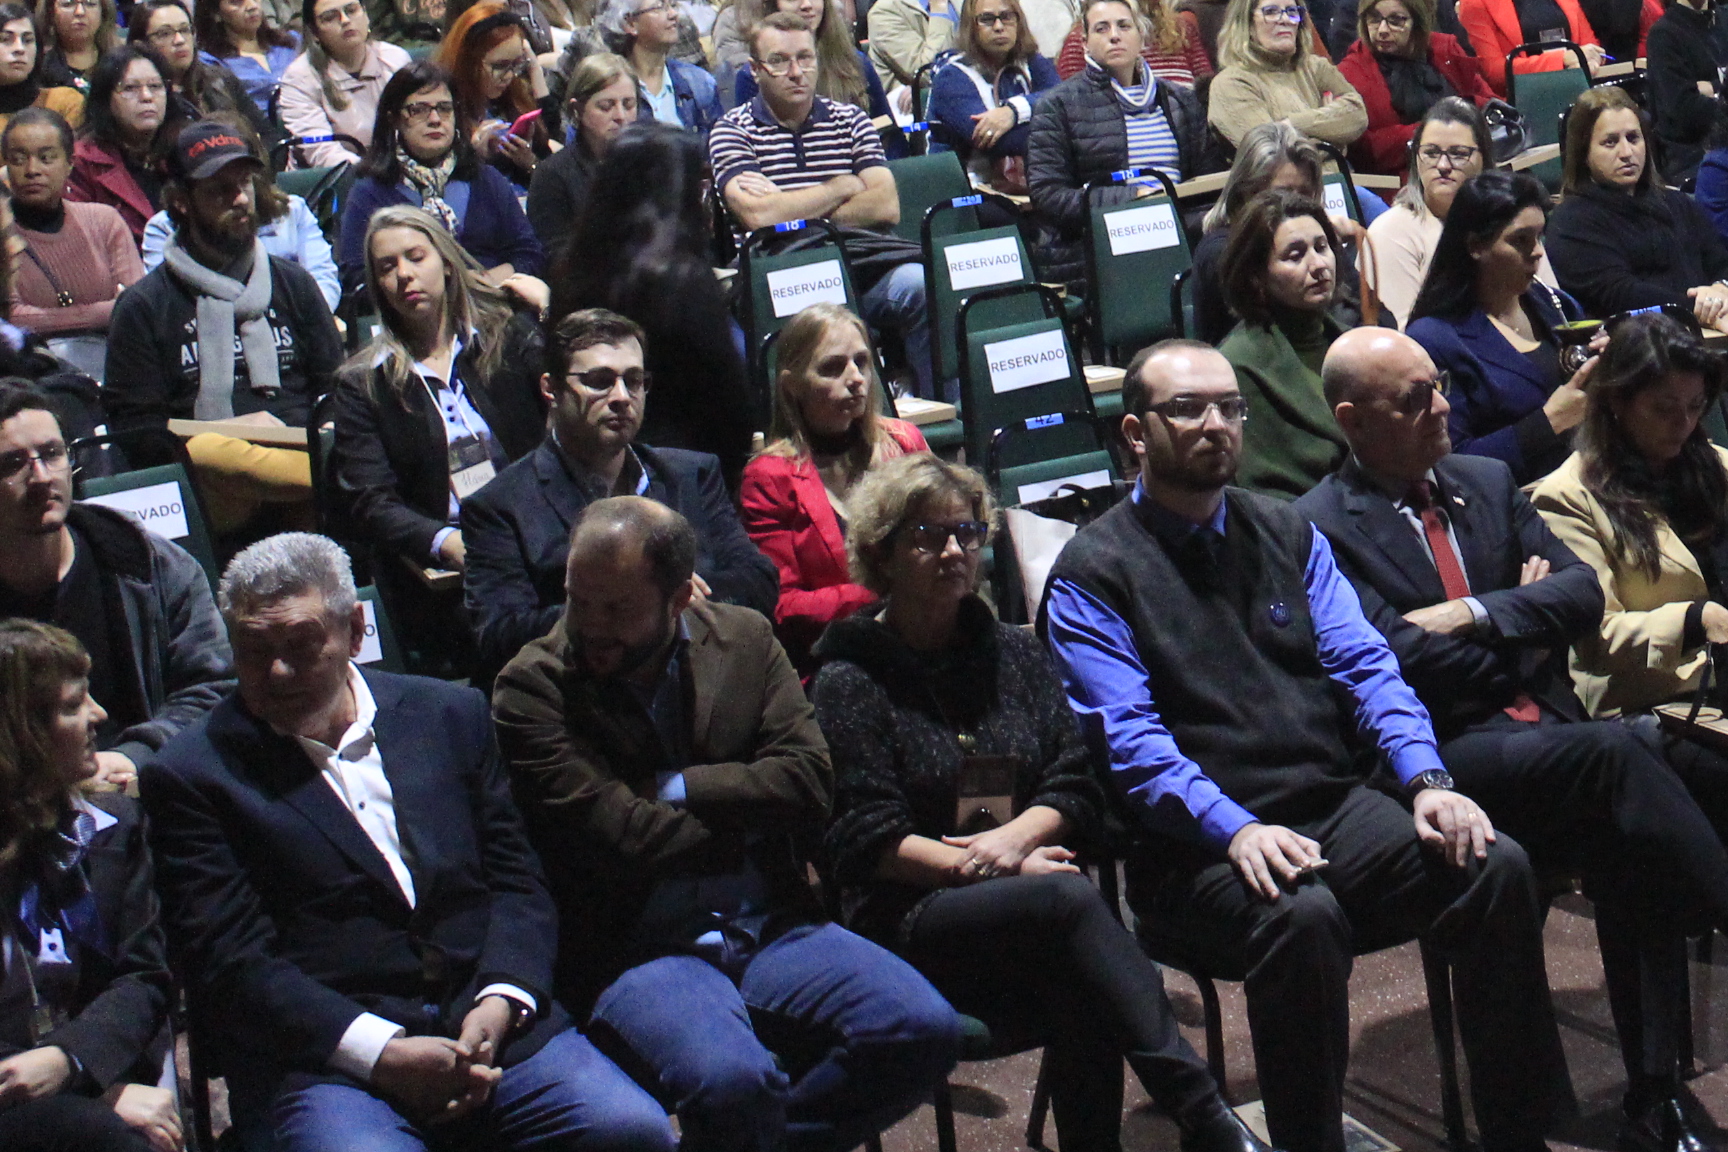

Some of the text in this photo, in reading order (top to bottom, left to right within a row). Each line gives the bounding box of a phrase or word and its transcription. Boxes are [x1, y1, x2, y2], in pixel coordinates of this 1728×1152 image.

[1109, 219, 1175, 239] RESERVADO
[949, 251, 1020, 273] RESERVADO
[771, 276, 843, 299] RESERVADO
[990, 348, 1065, 374] RESERVADO
